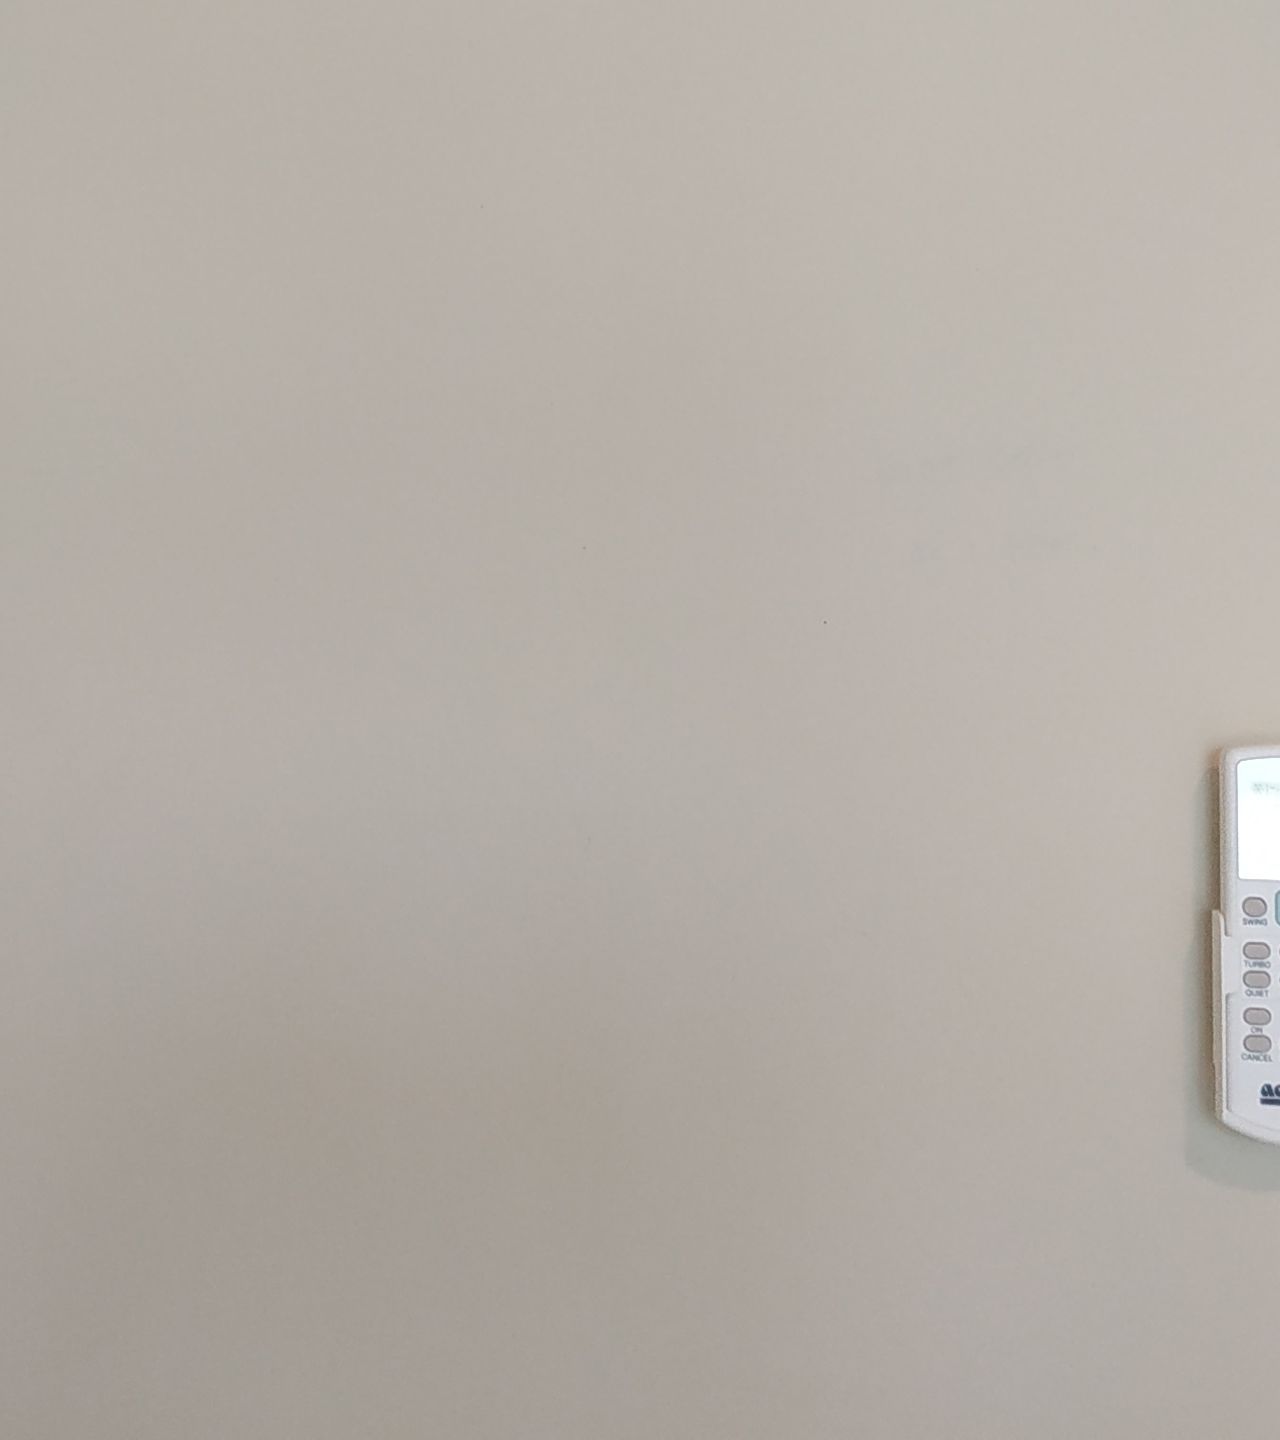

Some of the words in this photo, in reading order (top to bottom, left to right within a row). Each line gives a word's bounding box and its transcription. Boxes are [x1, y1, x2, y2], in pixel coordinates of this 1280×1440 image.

[1242, 917, 1268, 926] SWING
[1244, 960, 1272, 969] TURBO
[1244, 988, 1270, 997] QUIET
[1250, 1025, 1264, 1034] ON
[1240, 1053, 1273, 1062] CANCEL
